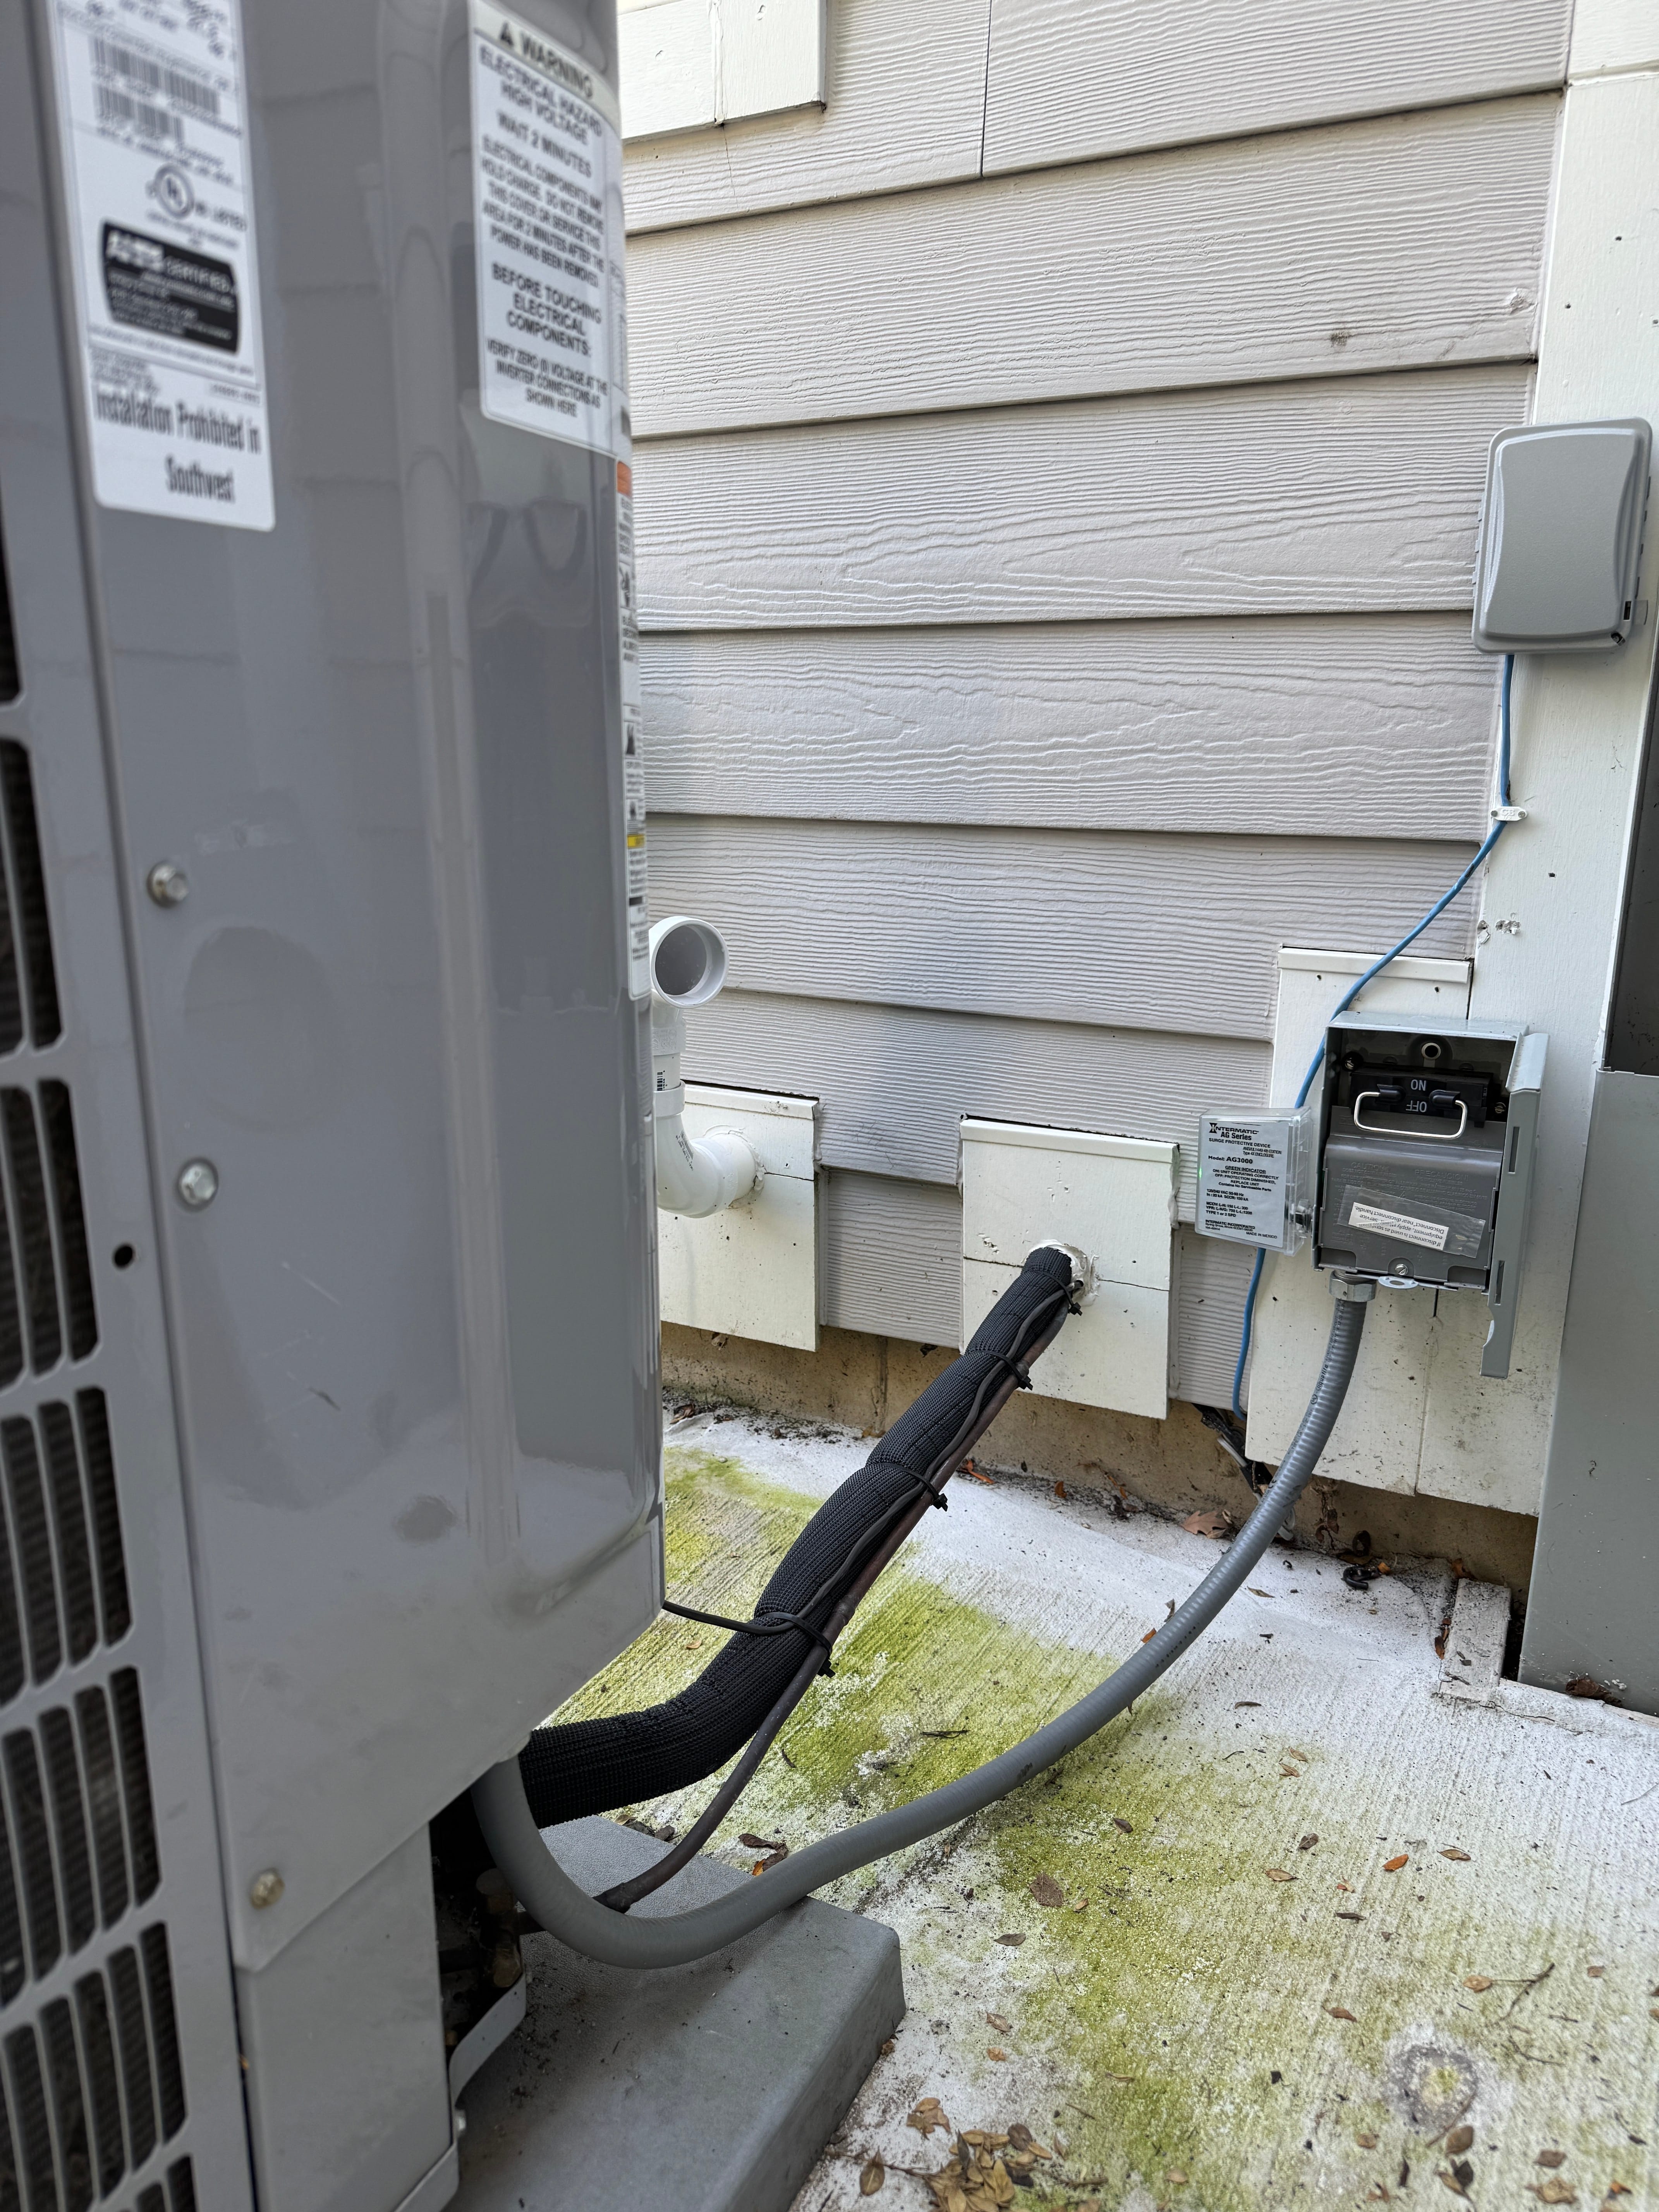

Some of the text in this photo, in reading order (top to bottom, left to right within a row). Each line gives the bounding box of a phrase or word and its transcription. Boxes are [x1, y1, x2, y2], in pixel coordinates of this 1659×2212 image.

[480, 45, 602, 137] ELECTRICAL HAZARD
[521, 33, 593, 100] WARNING
[501, 82, 588, 145] HIGH VOLTAGE
[483, 136, 532, 175] ELECTRICAL
[536, 164, 589, 205] COMPONENTS
[497, 111, 591, 178] WAIT 2 MINUTES
[483, 158, 504, 180] HOLD
[546, 190, 559, 210] DO
[560, 196, 576, 217] NOT
[577, 207, 603, 235] REMOVE
[489, 179, 600, 252] THIS COVER OR SERVICE THIS
[490, 224, 522, 252] POWER
[523, 241, 540, 261] HAS
[541, 249, 562, 270] BEEN
[507, 214, 524, 232] FOR
[533, 224, 567, 253] MINUTES
[568, 242, 591, 266] AFTER
[592, 254, 604, 273] THE
[492, 263, 602, 324] BEFORE TOUCHING
[514, 292, 586, 336] ELECTRICAL
[488, 339, 608, 397] VERIFY ZERO (0) VOLTAGE AT THE
[496, 359, 601, 409] INVERTER CONNECTIONS AS
[97, 392, 172, 436] Installation
[176, 399, 245, 452] Prohibited
[247, 416, 261, 455] in
[526, 388, 577, 417] SHOWN HERE
[165, 454, 235, 504] Southwest
[1406, 1099, 1427, 1113] OFF
[1410, 1079, 1427, 1091] ON
[1209, 1122, 1259, 1134] INTERMATIC
[1374, 1211, 1401, 1222] disconnect
[1396, 1223, 1443, 1240] equipment, apply
[1409, 1234, 1436, 1246] disconnect
